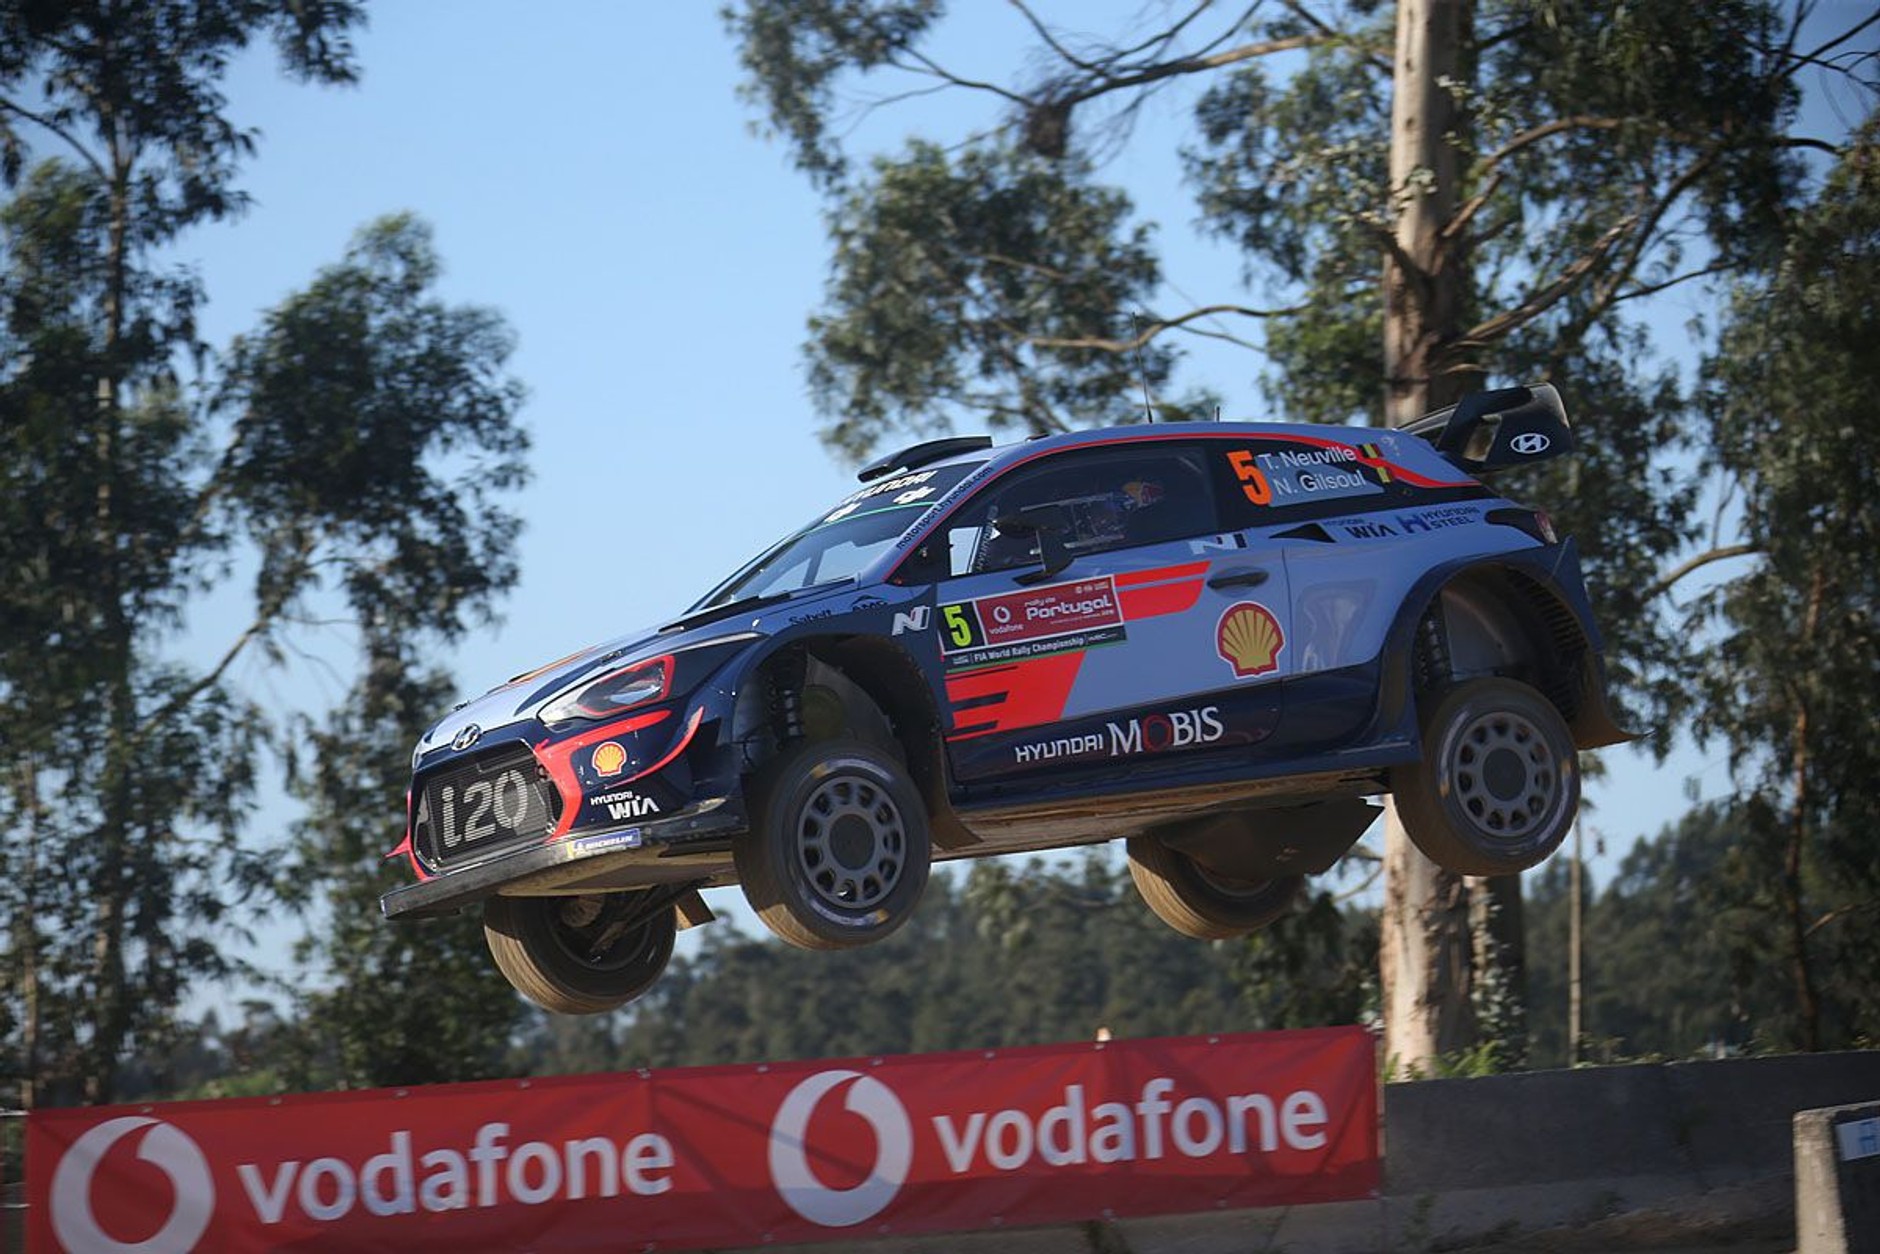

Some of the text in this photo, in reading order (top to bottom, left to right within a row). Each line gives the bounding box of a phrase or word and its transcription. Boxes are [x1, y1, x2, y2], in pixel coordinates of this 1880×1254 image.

[1257, 446, 1357, 470] T. Neuville
[1226, 450, 1273, 506] 5
[1273, 470, 1367, 496] N. Gilsoul
[896, 466, 994, 549] motorsport.hyundai.com
[1420, 506, 1482, 521] HYUNDAI
[1428, 515, 1476, 530] STEEL
[1026, 594, 1113, 621] Portugal
[943, 604, 972, 647] 5
[988, 623, 1025, 635] vodafone
[974, 651, 987, 662] FIA
[988, 647, 1010, 660] World
[1012, 644, 1031, 658] Rally
[1032, 636, 1085, 653] Championship
[1015, 706, 1224, 763] HYUNDAI MOBIS
[441, 769, 528, 848] i20
[590, 790, 634, 806] HYUNDAI
[932, 1078, 1330, 1173] vodafone
[237, 1122, 675, 1225] vodafone
